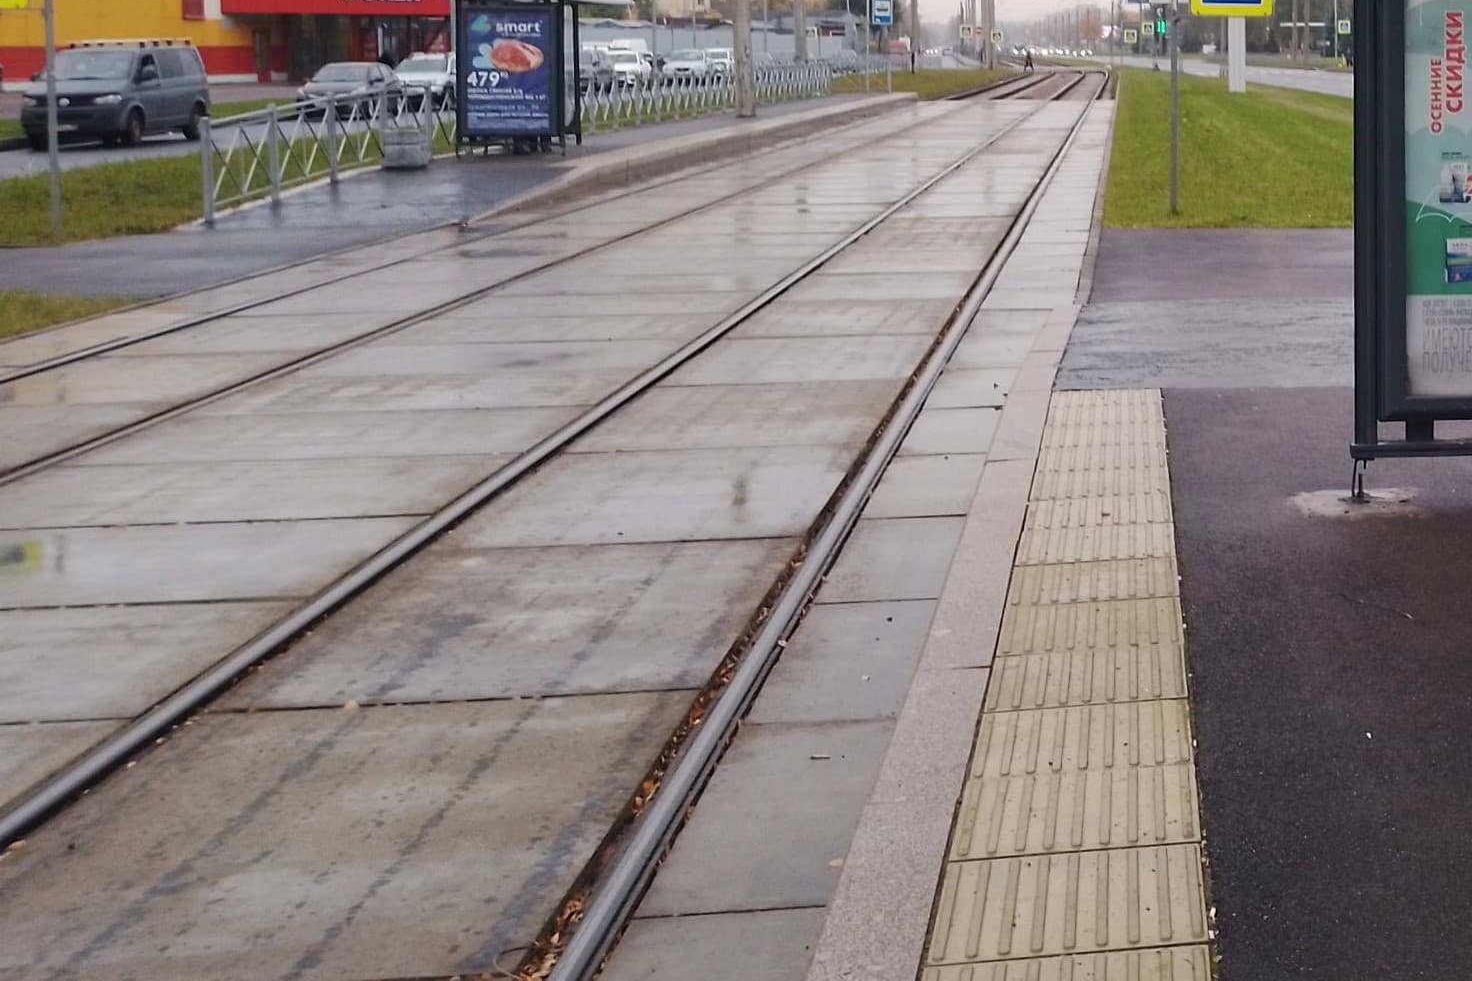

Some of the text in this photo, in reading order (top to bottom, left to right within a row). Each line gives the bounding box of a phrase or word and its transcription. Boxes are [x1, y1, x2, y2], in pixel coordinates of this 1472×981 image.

[496, 21, 541, 33] smart
[467, 71, 500, 87] 479
[1446, 12, 1466, 113] СКИДКИ
[1431, 59, 1442, 133] ОСЕННИЕ
